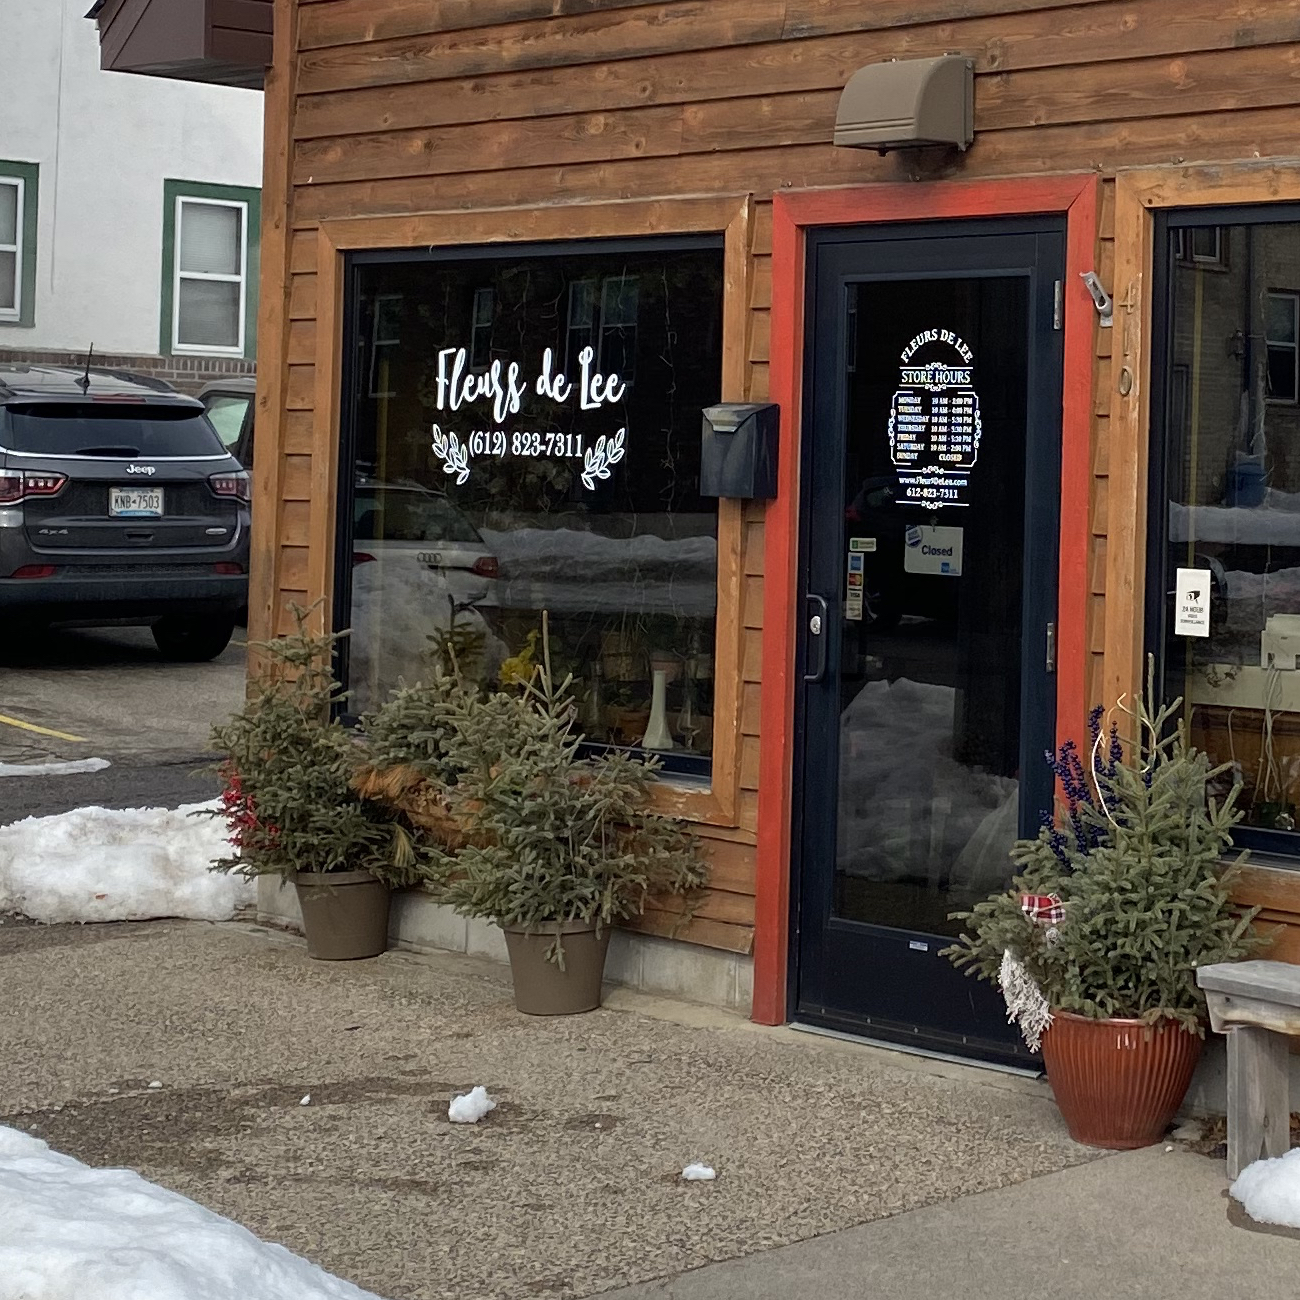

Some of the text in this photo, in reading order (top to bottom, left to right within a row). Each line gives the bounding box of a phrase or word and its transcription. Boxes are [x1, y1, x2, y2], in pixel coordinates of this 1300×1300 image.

[900, 328, 974, 364] FLEURS DE LEE
[901, 370, 970, 384] STORE HOURS
[436, 345, 626, 424] Fleurs de Lee
[468, 430, 583, 458] (612) 823-7311
[126, 464, 156, 476] Jeep
[906, 486, 958, 499] 612-823-7311
[921, 544, 953, 557] Closed
